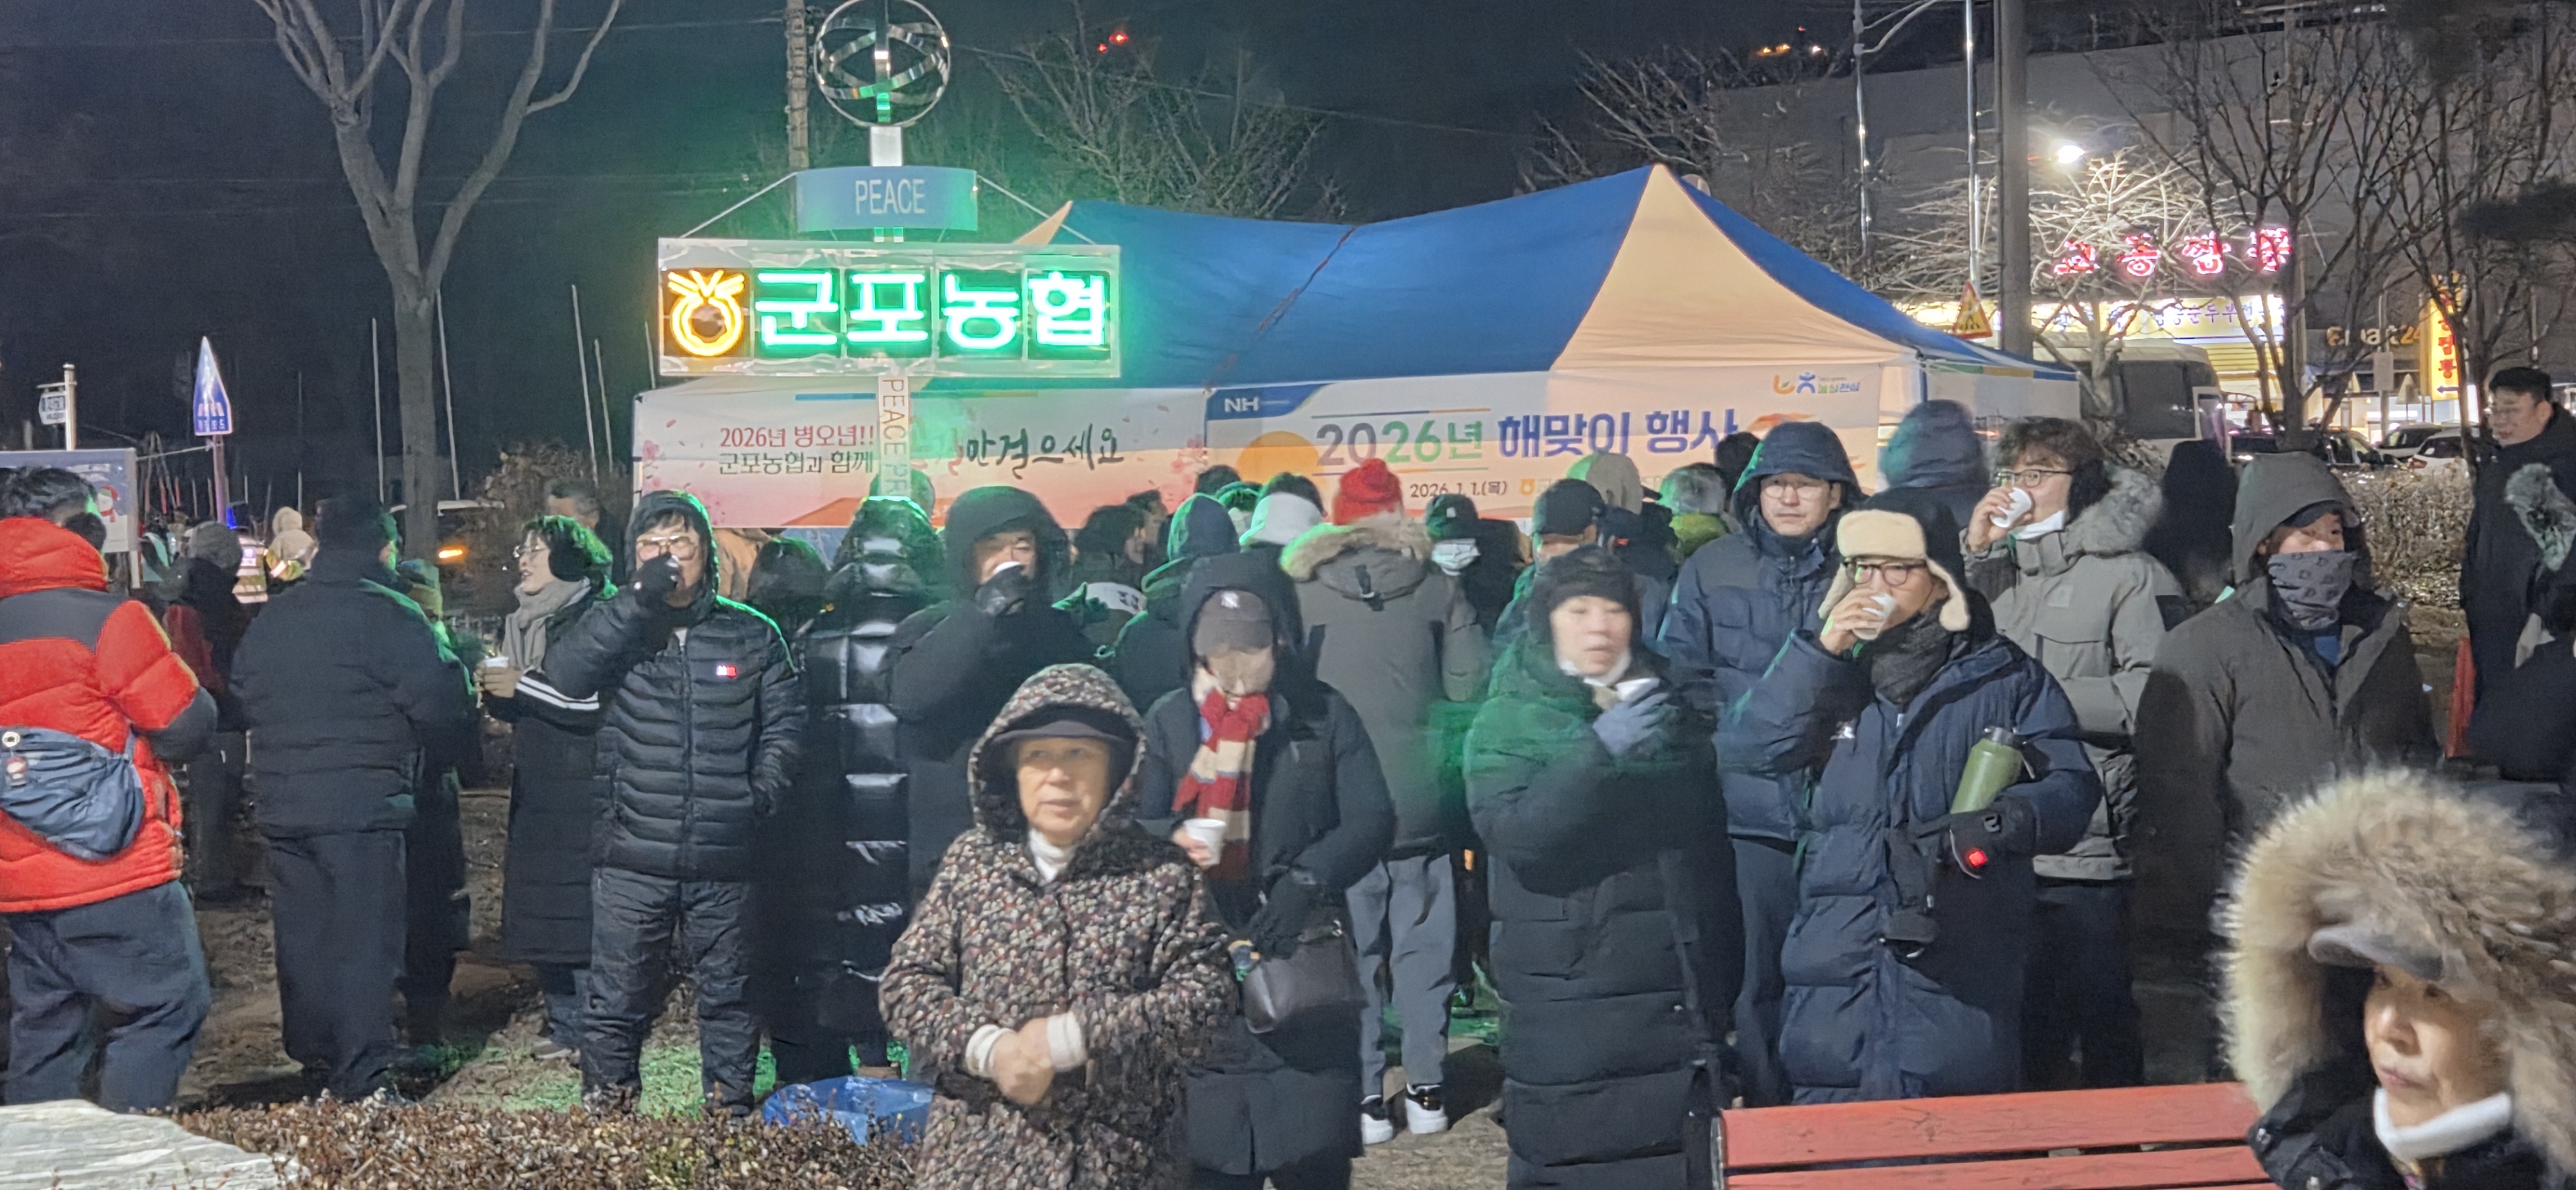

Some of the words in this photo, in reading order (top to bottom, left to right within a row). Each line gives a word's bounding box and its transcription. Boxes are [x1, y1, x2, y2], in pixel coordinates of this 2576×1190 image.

[855, 178, 926, 215] PEACE
[755, 270, 1108, 350] 군포농협
[882, 379, 907, 455] PEACE
[1224, 396, 1259, 412] NH
[719, 427, 786, 448] 2026년
[794, 424, 874, 448] 병오년!!
[1316, 420, 1482, 466] 2026년
[1498, 412, 1631, 458] 해맞이
[1645, 408, 1738, 454] 행사
[719, 450, 822, 475] 군포농협과
[831, 450, 873, 474] 함께
